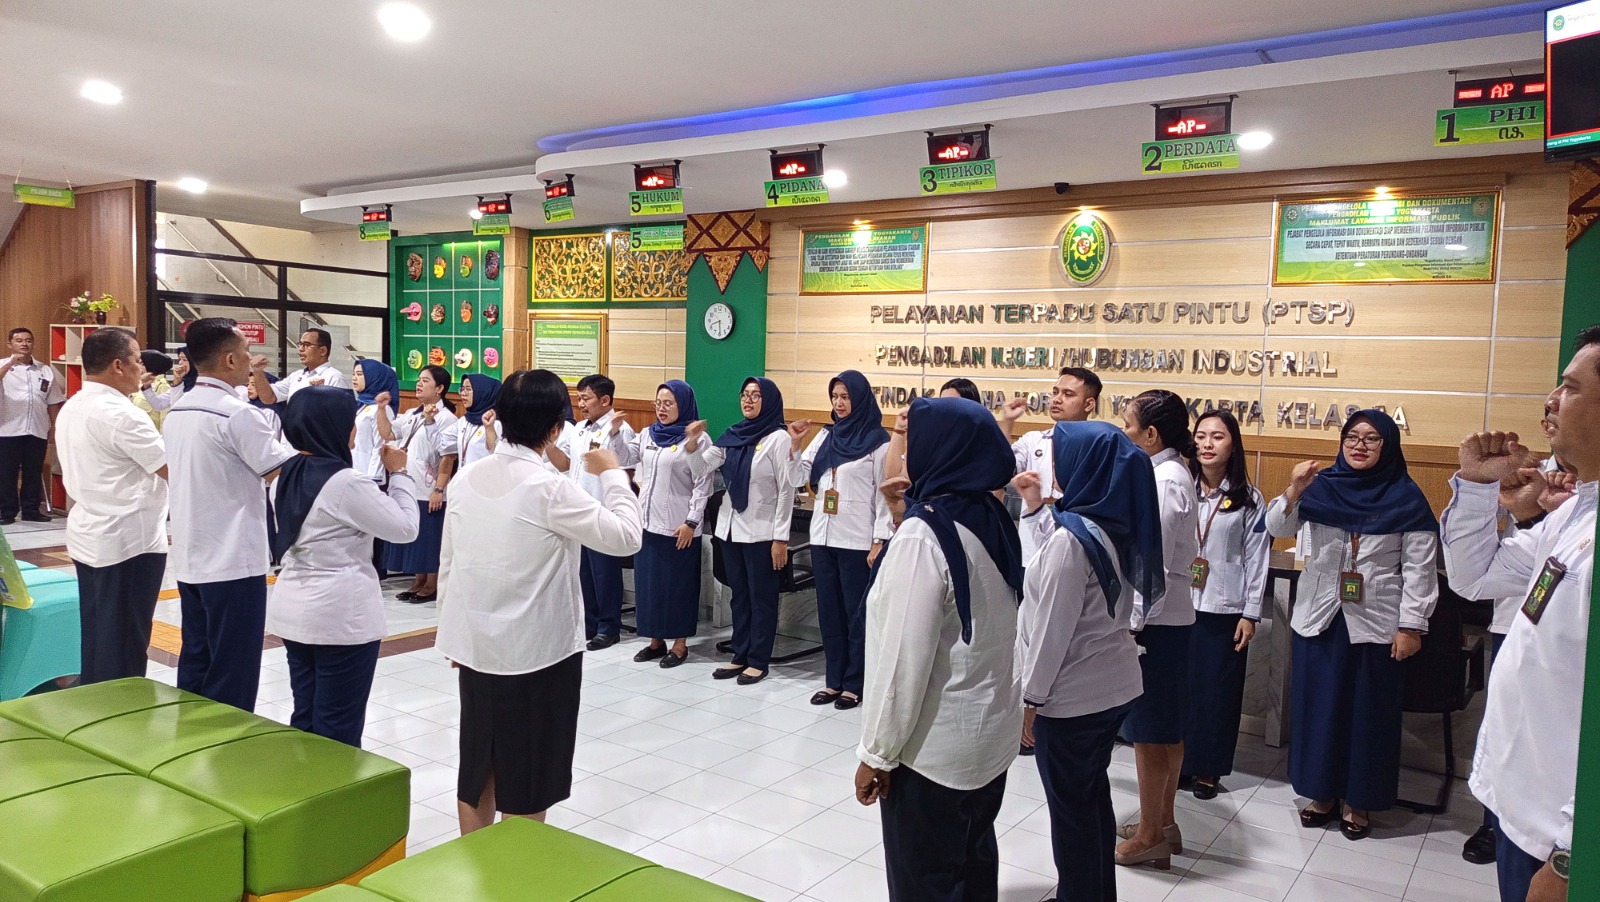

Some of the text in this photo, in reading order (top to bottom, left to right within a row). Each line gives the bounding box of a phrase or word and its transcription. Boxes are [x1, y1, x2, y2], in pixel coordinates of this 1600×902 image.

[1489, 106, 1538, 123] PHI
[1439, 112, 1460, 143] 1
[1164, 138, 1237, 158] PERDATA
[1144, 145, 1163, 171] 2
[937, 163, 993, 179] TIPIKOR
[780, 179, 826, 193] PIDANA
[923, 169, 938, 193] 3
[631, 194, 642, 213] 5
[642, 191, 680, 203] HUKUM
[767, 183, 780, 205] 4
[1407, 199, 1421, 207] DAN
[1422, 197, 1472, 206] DOKUMENTASI
[544, 204, 551, 220] 6
[1309, 218, 1349, 226] MAKLUMAT
[1431, 213, 1461, 221] PUBLIK
[359, 226, 366, 240] 8
[631, 230, 642, 249] 5
[871, 298, 1355, 327] PELAYANAN TERPADU SATU PINTU (PTSP)
[875, 345, 1338, 376] PENGADILAN NEGERI /HUBUNGAN INDUSTRIAL
